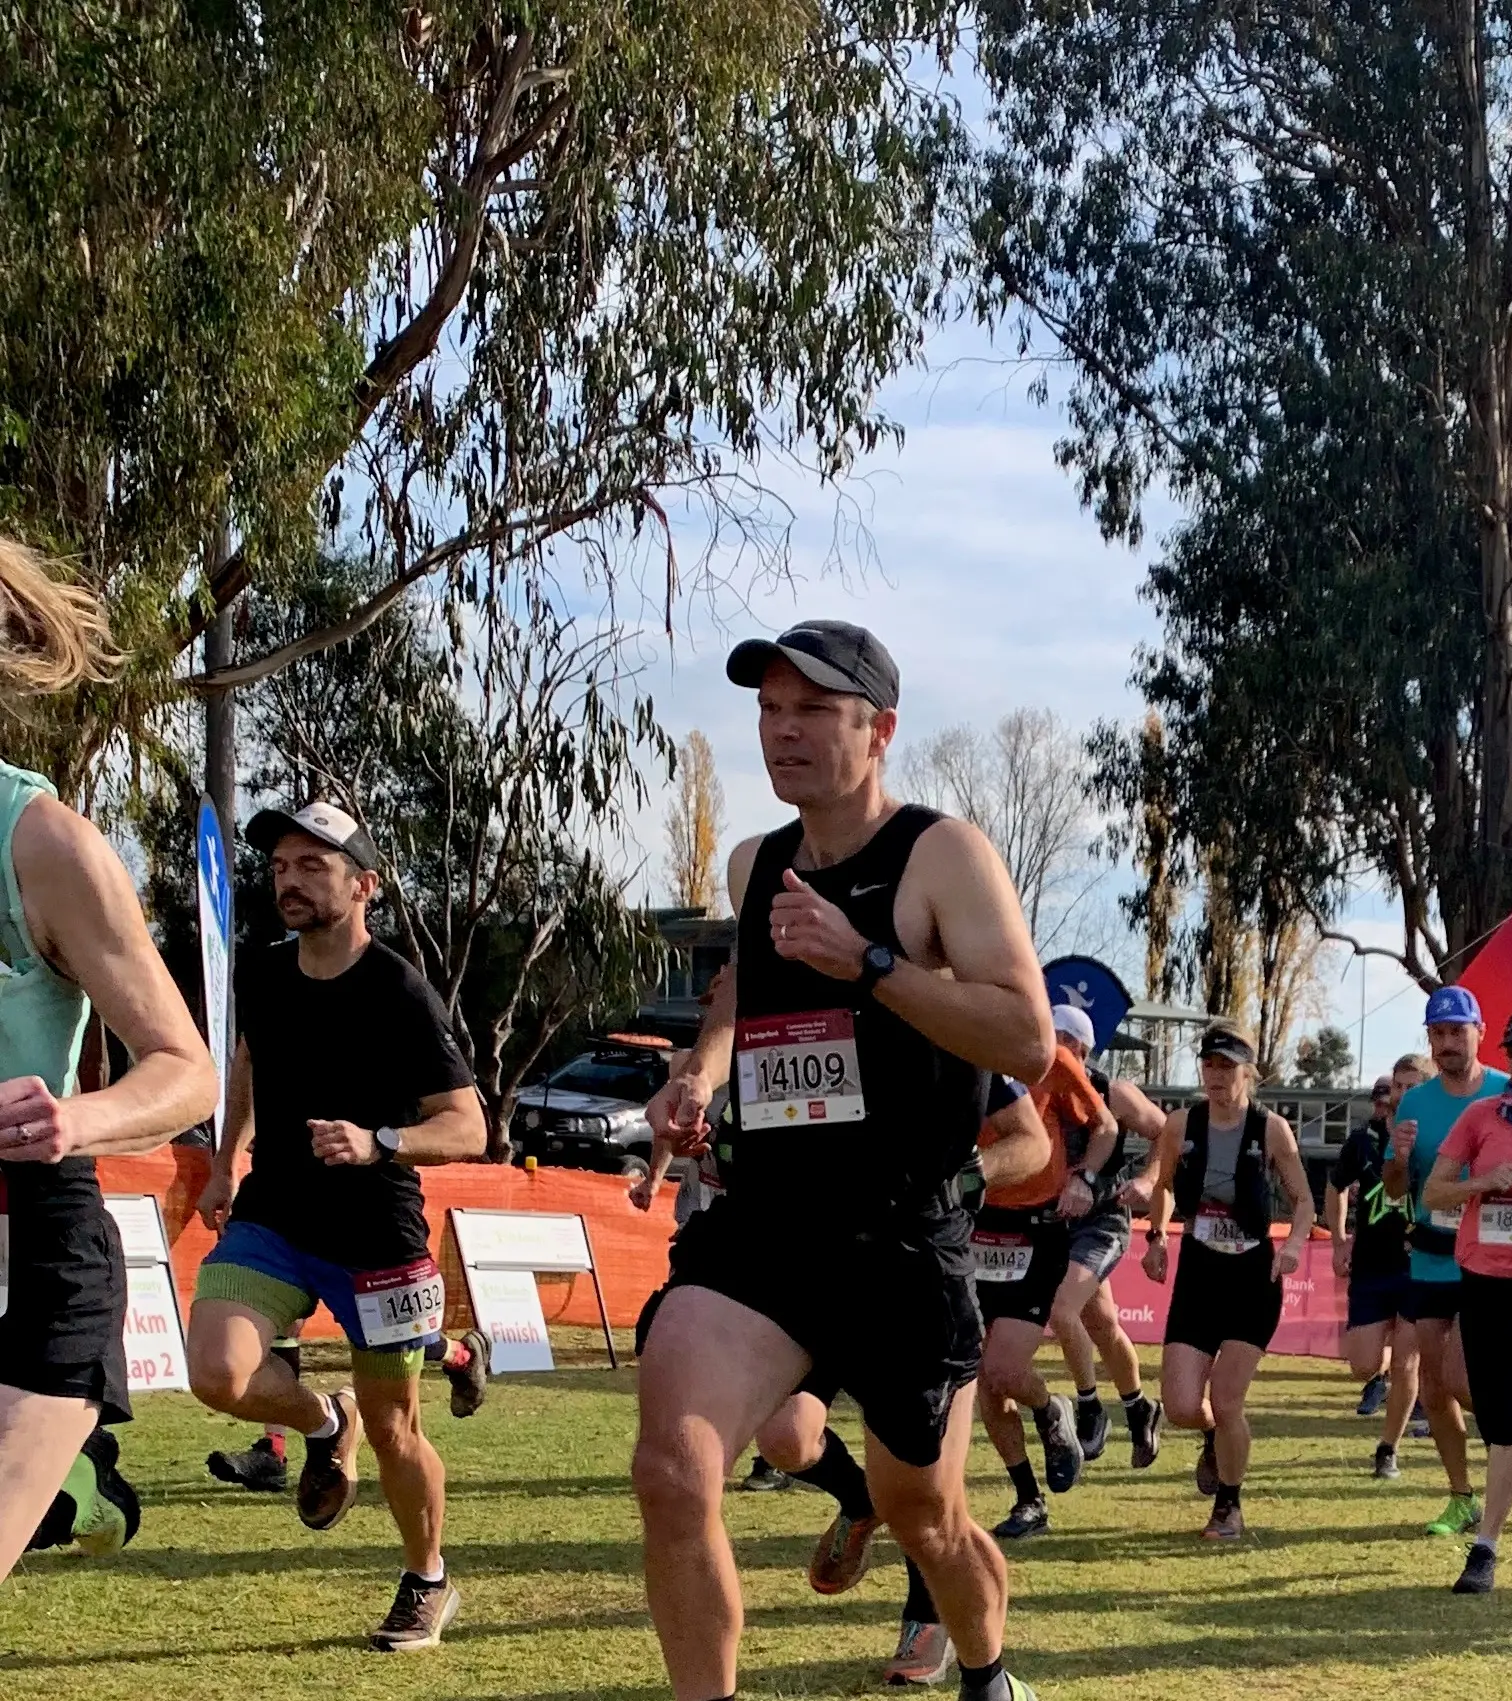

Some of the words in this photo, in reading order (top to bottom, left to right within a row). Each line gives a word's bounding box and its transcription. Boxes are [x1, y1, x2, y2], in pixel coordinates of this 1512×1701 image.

[760, 1052, 846, 1093] 14109
[1284, 1277, 1315, 1292] Bank
[386, 1284, 441, 1319] 14132
[124, 1308, 168, 1335] 1km
[490, 1321, 541, 1344] Finish
[127, 1356, 157, 1385] ap
[160, 1352, 175, 1377] 2
